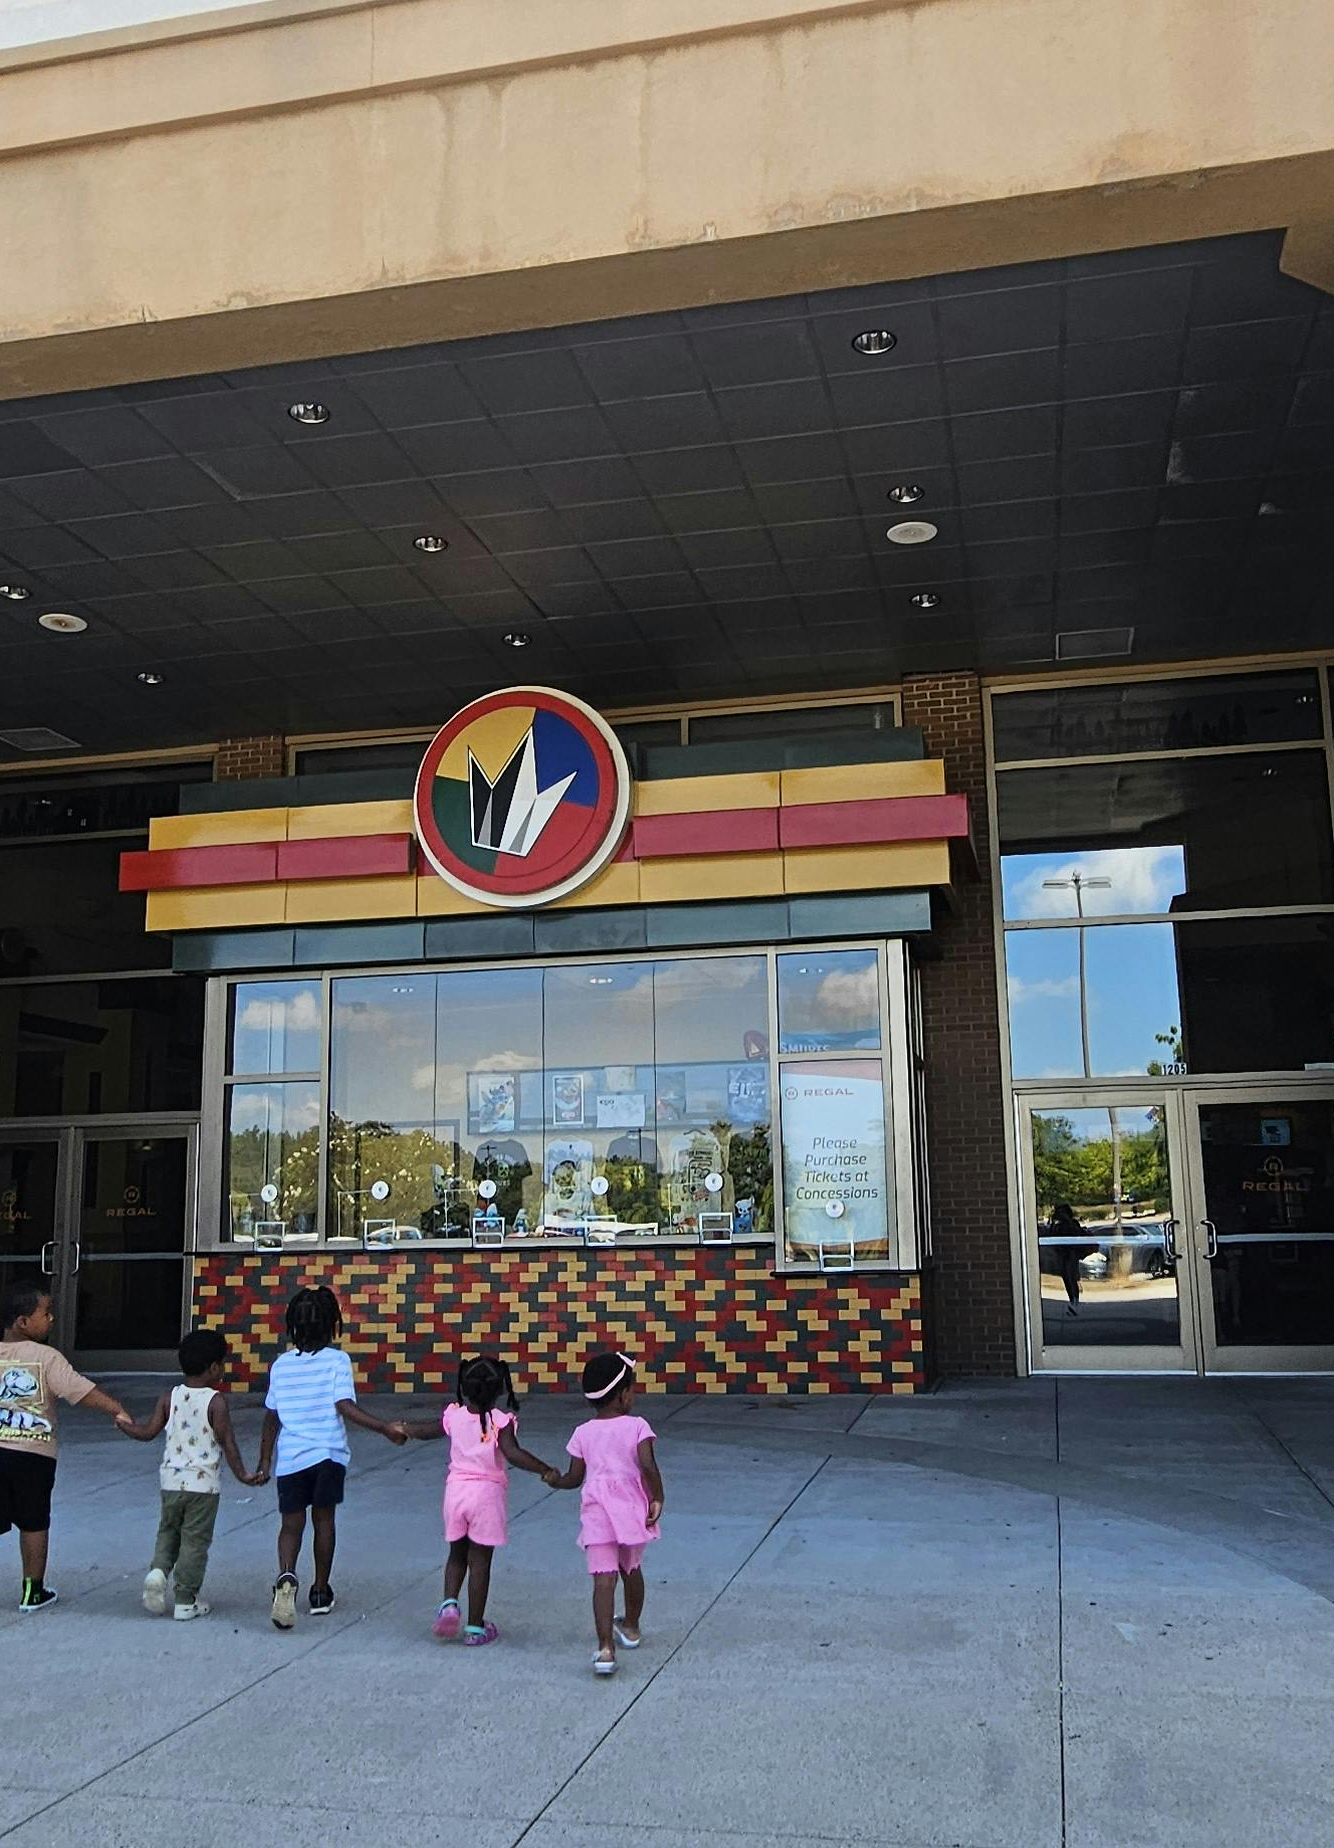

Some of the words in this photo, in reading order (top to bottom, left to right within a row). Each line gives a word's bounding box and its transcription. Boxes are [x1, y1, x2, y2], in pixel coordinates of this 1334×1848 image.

[1162, 1063, 1186, 1075] 1205
[803, 1087, 855, 1097] REGAL
[812, 1137, 858, 1149] Please
[804, 1154, 868, 1167] Purchase
[805, 1170, 852, 1183] Tickets
[855, 1171, 870, 1183] at
[1243, 1180, 1309, 1192] REGAL
[796, 1186, 879, 1200] Concessions
[106, 1207, 157, 1217] REGAL
